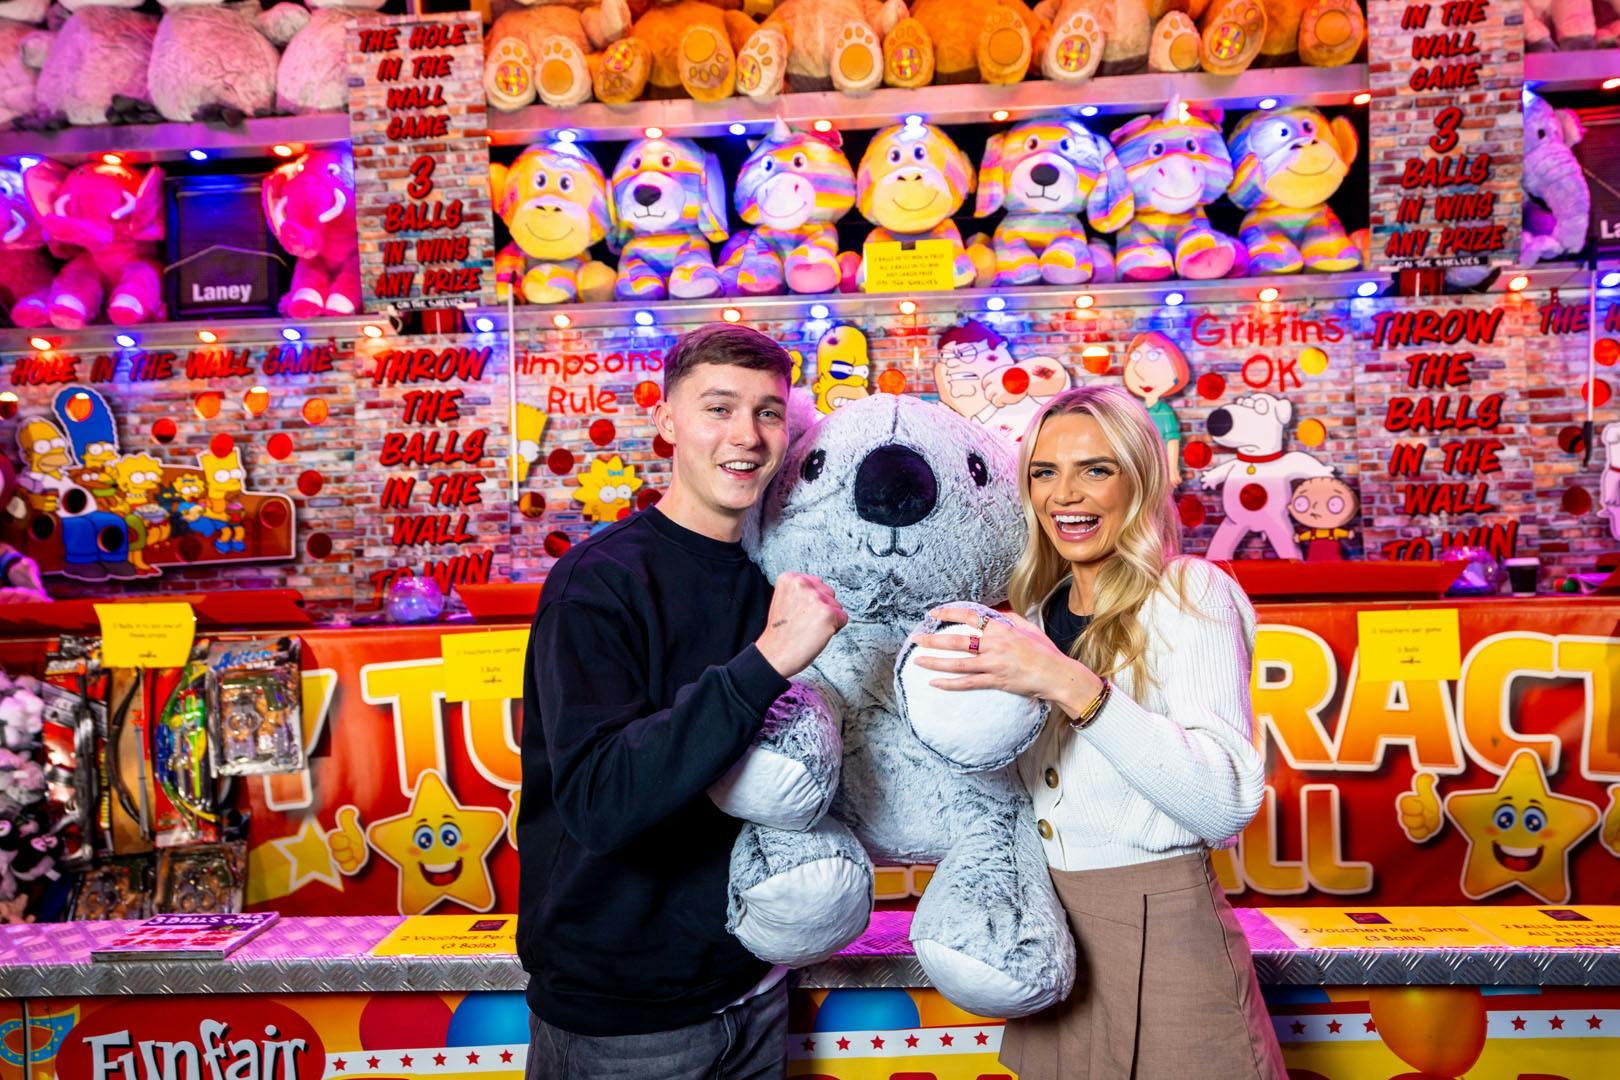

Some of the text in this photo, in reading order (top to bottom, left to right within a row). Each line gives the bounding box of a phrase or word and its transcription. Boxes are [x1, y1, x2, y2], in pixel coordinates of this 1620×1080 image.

[1401, 0, 1489, 30] IN THE
[358, 24, 469, 53] THE HOLE
[1412, 31, 1480, 60] WALL
[377, 54, 454, 82] IN THE
[1409, 62, 1482, 92] GAME
[387, 84, 447, 111] WALL
[386, 114, 450, 140] GAME
[1429, 106, 1464, 153] 3
[407, 155, 435, 199] 3
[1401, 153, 1492, 189] BALLS
[384, 199, 463, 234] BALLS
[1397, 192, 1496, 224] IN WINS
[383, 236, 470, 267] IN WINS
[1385, 225, 1507, 257] ANY PRIZE
[1436, 257, 1480, 266] SHELVES
[192, 283, 252, 303] Laney
[374, 268, 483, 298] ANY PRIZE
[1191, 311, 1345, 346] Griffins
[1371, 307, 1504, 346] THROW
[1538, 304, 1590, 335] THE
[11, 346, 334, 385] HOLE IN THE WALL GAME
[373, 346, 493, 384] THROW
[514, 349, 664, 383] impsons
[1242, 354, 1302, 392] OK
[1405, 352, 1475, 388] THE
[402, 389, 464, 424] THE
[548, 384, 618, 414] Rule
[1384, 393, 1504, 432] BALLS
[380, 428, 488, 466] BALLS
[1388, 439, 1505, 476] IN THE
[381, 472, 486, 509] IN THE
[1404, 483, 1495, 517] WALL
[392, 513, 474, 547] WALL
[1382, 537, 1433, 561] TO
[424, 549, 494, 596] WIN
[1210, 784, 1374, 895] LL
[82, 1018, 307, 1080] Funfair
